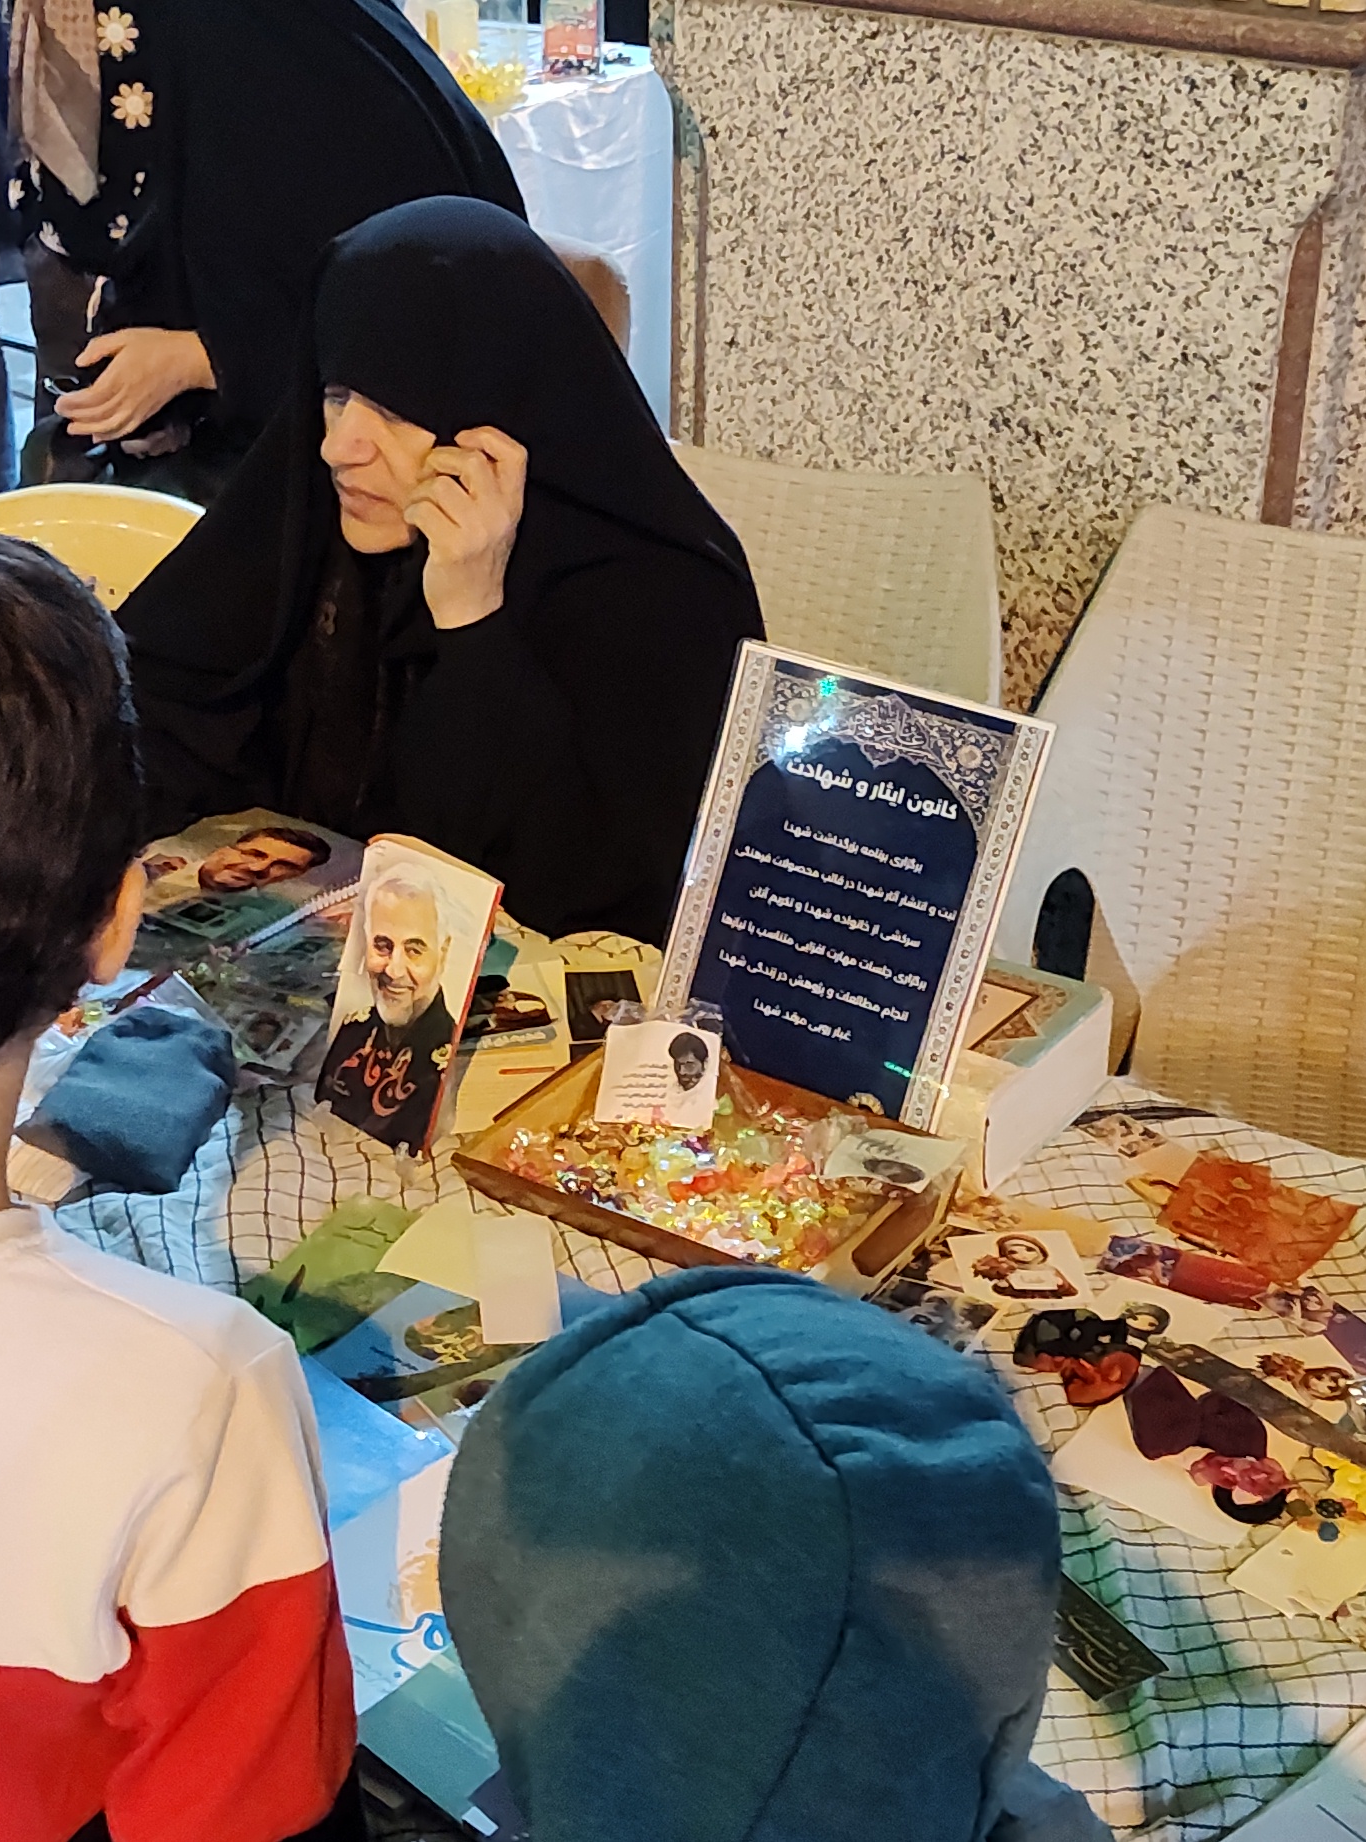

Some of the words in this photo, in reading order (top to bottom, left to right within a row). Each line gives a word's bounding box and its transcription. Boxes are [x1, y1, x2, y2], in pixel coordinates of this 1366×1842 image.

[784, 757, 854, 790] شهادت
[855, 780, 869, 798] و
[868, 781, 906, 808] ایثار
[906, 793, 959, 819] کانون
[783, 820, 812, 838] شهدا
[812, 830, 860, 855] بزرگداشت
[734, 845, 772, 864] فرهنگی
[860, 845, 889, 864] برنامه
[771, 856, 820, 878] محصولات
[888, 856, 924, 874] برگزاری
[749, 886, 770, 899] آنان
[843, 880, 855, 890] در
[856, 881, 885, 898] شهدا
[794, 901, 803, 913] و
[803, 901, 831, 920] شهدا
[898, 895, 929, 912] انتشار
[928, 905, 937, 917] و
[747, 921, 756, 935] با
[832, 914, 870, 932] خانواده
[755, 928, 795, 946] متناسب
[879, 929, 921, 948] سرکشی
[718, 949, 747, 968] شهدا
[826, 948, 857, 967] مهارت
[746, 961, 778, 980] زندگی
[775, 971, 788, 982] در
[858, 959, 893, 979] جلسات
[788, 975, 826, 998] پژوهش
[892, 973, 928, 992] برگزاری
[826, 988, 835, 1000] و
[835, 990, 881, 1013] مطالعات
[753, 998, 782, 1017] شهدا
[880, 1006, 910, 1022] انجام
[781, 1011, 808, 1026] مرقد
[333, 1026, 393, 1088] قاسم
[372, 1047, 417, 1117] حاج
